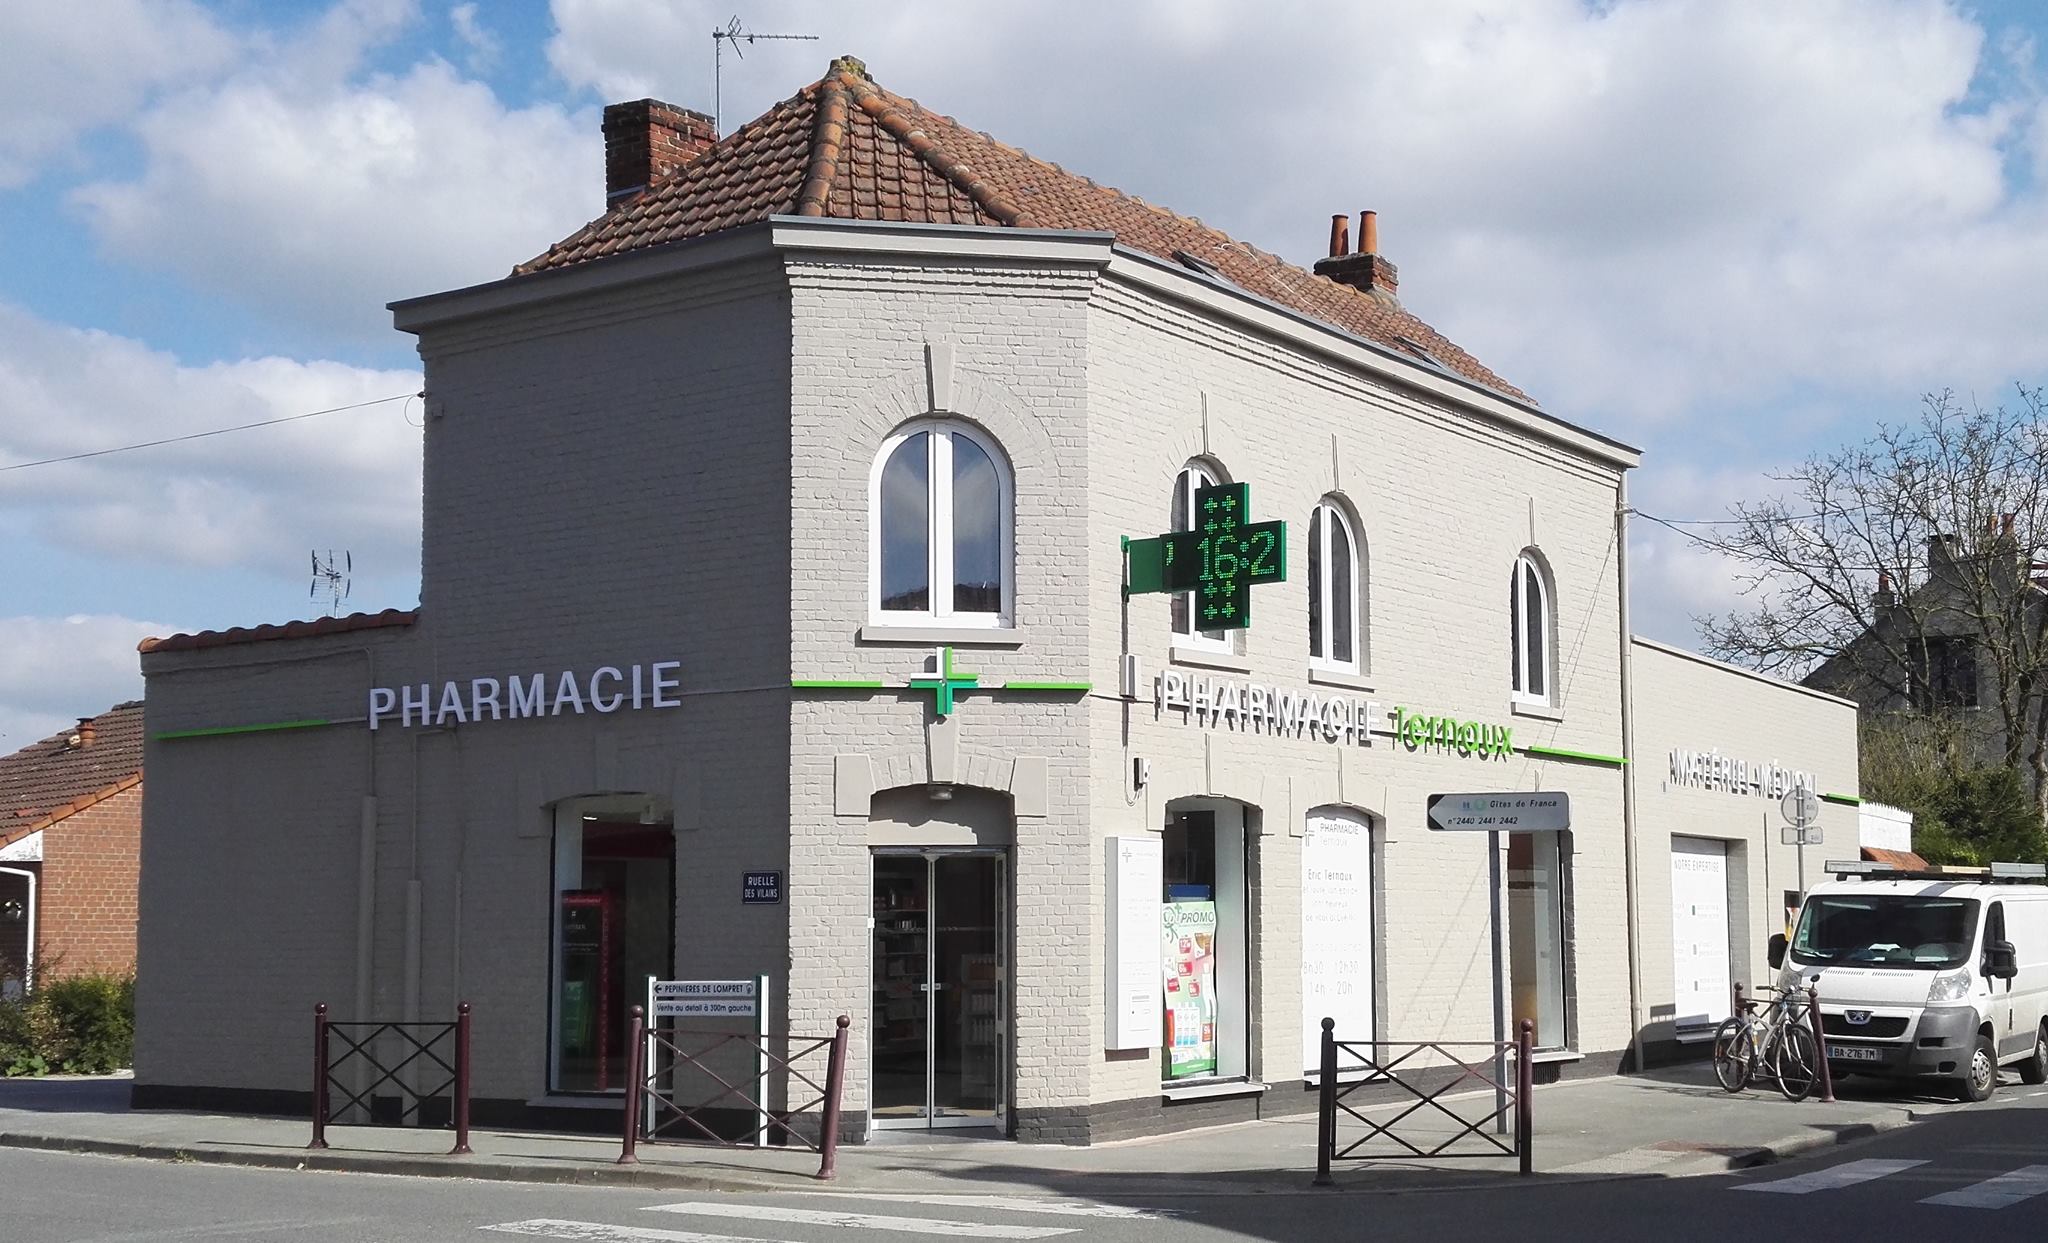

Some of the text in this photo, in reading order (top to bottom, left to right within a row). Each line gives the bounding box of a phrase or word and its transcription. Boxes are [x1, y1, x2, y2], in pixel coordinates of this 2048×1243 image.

[369, 660, 681, 731] PHARMACIE
[1160, 669, 1514, 756] PHARMACIE Ternaux
[1478, 816, 1496, 825] 2441
[1499, 816, 1519, 825] 2442
[1319, 822, 1360, 835] PHARMACIE
[747, 876, 775, 886] RUELLE
[744, 888, 778, 898] DES VILAINS
[1180, 911, 1215, 924] PROMO
[702, 984, 711, 994] DE
[713, 984, 744, 994] LOMPRET
[656, 1004, 674, 1013] Vente
[728, 1004, 752, 1015] gauche
